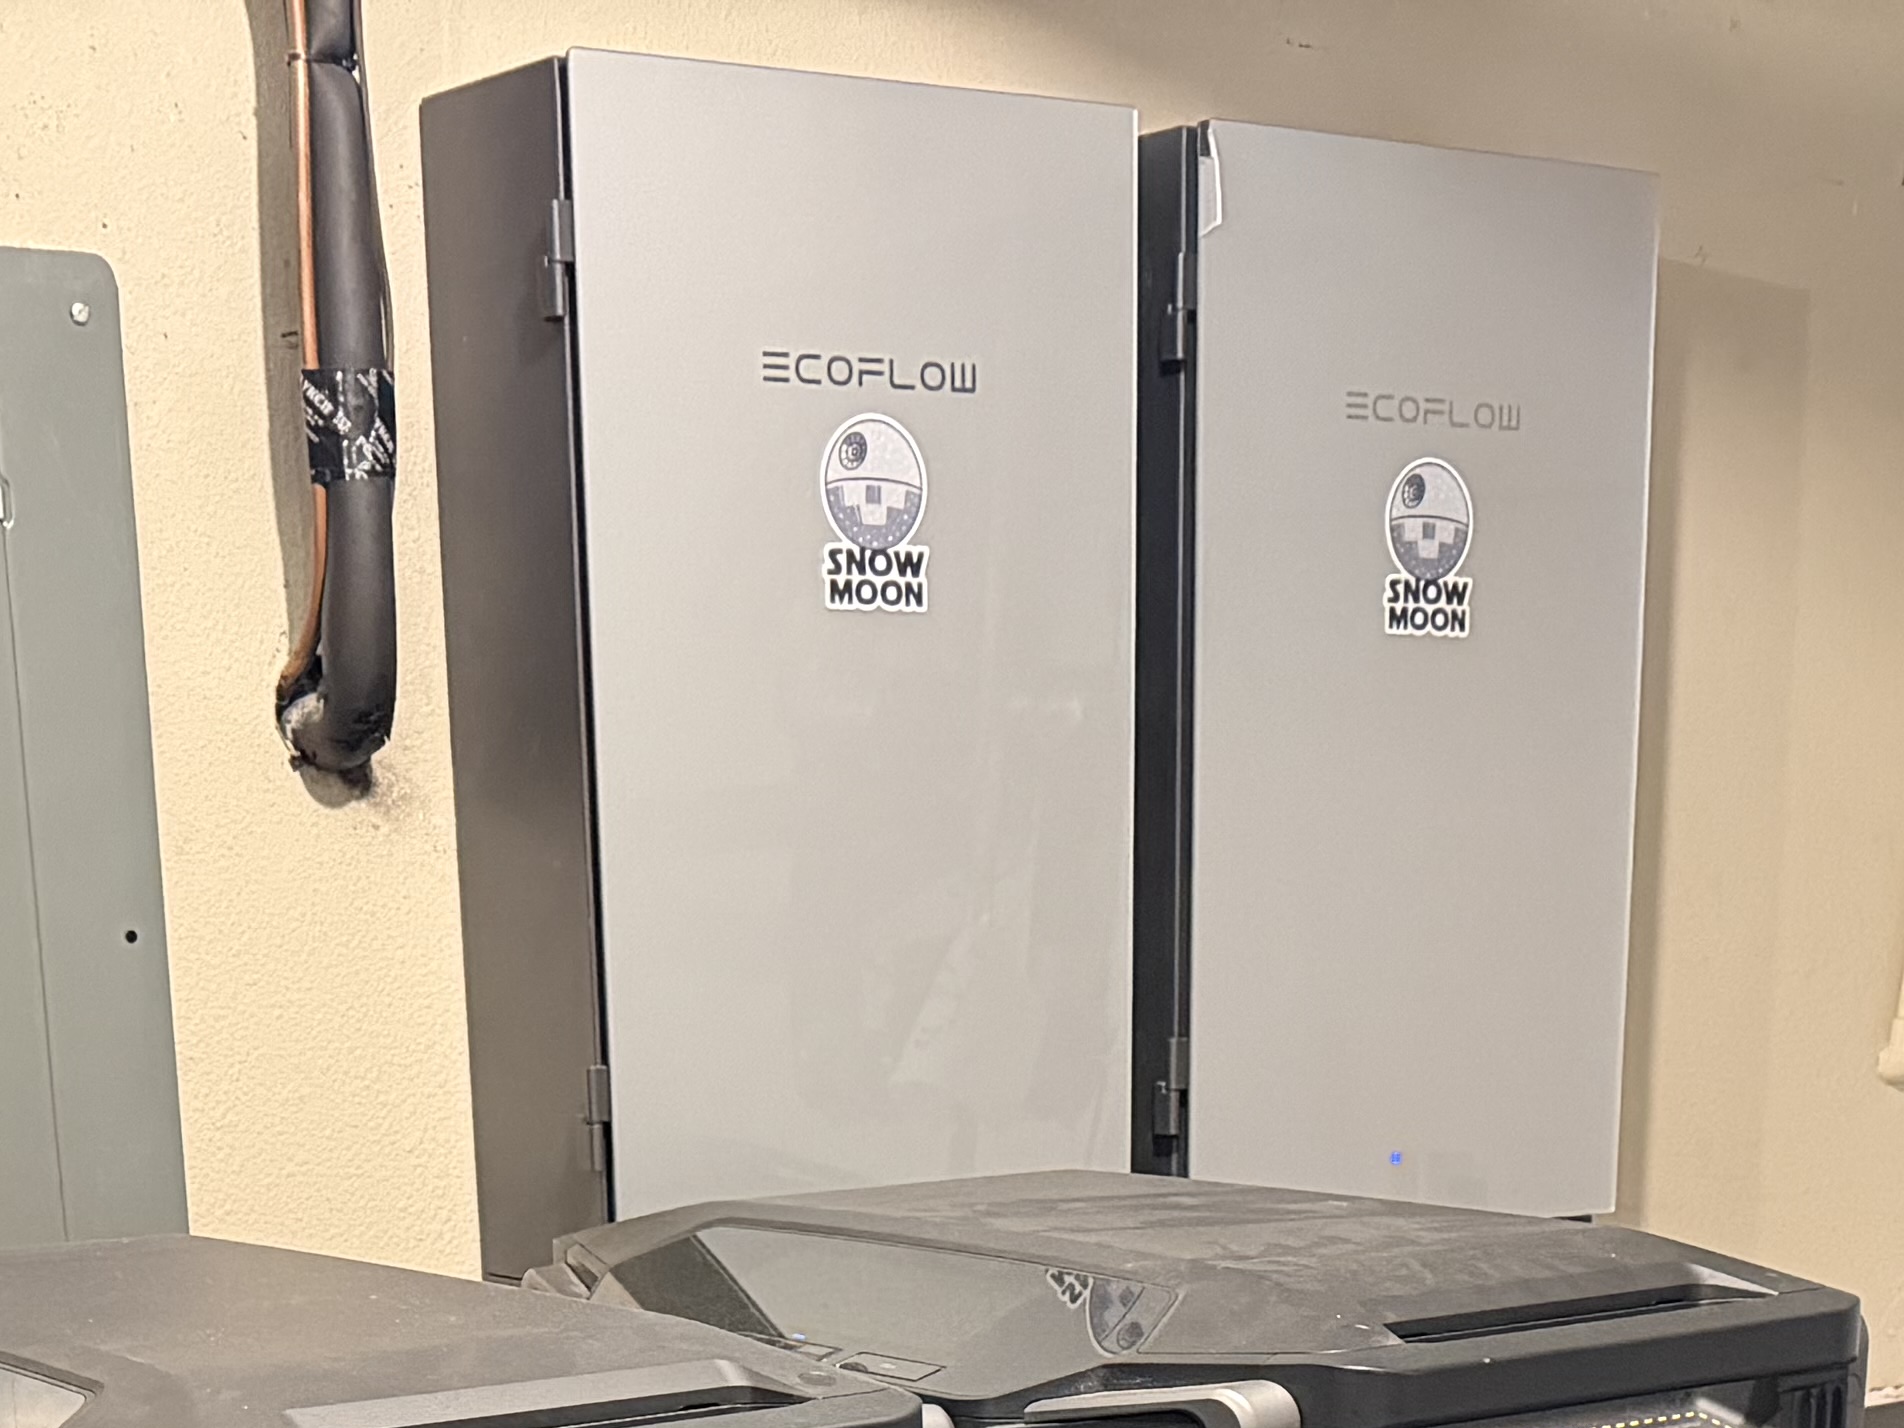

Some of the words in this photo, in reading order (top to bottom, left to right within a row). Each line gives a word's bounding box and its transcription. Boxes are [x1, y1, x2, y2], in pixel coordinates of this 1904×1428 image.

[762, 350, 977, 393] ECOFLOW
[1346, 391, 1521, 431] ECOFLOW
[826, 547, 924, 578] SNOW
[829, 578, 924, 607] MOON
[1386, 578, 1469, 606] SNOW
[1388, 606, 1466, 632] MOON
